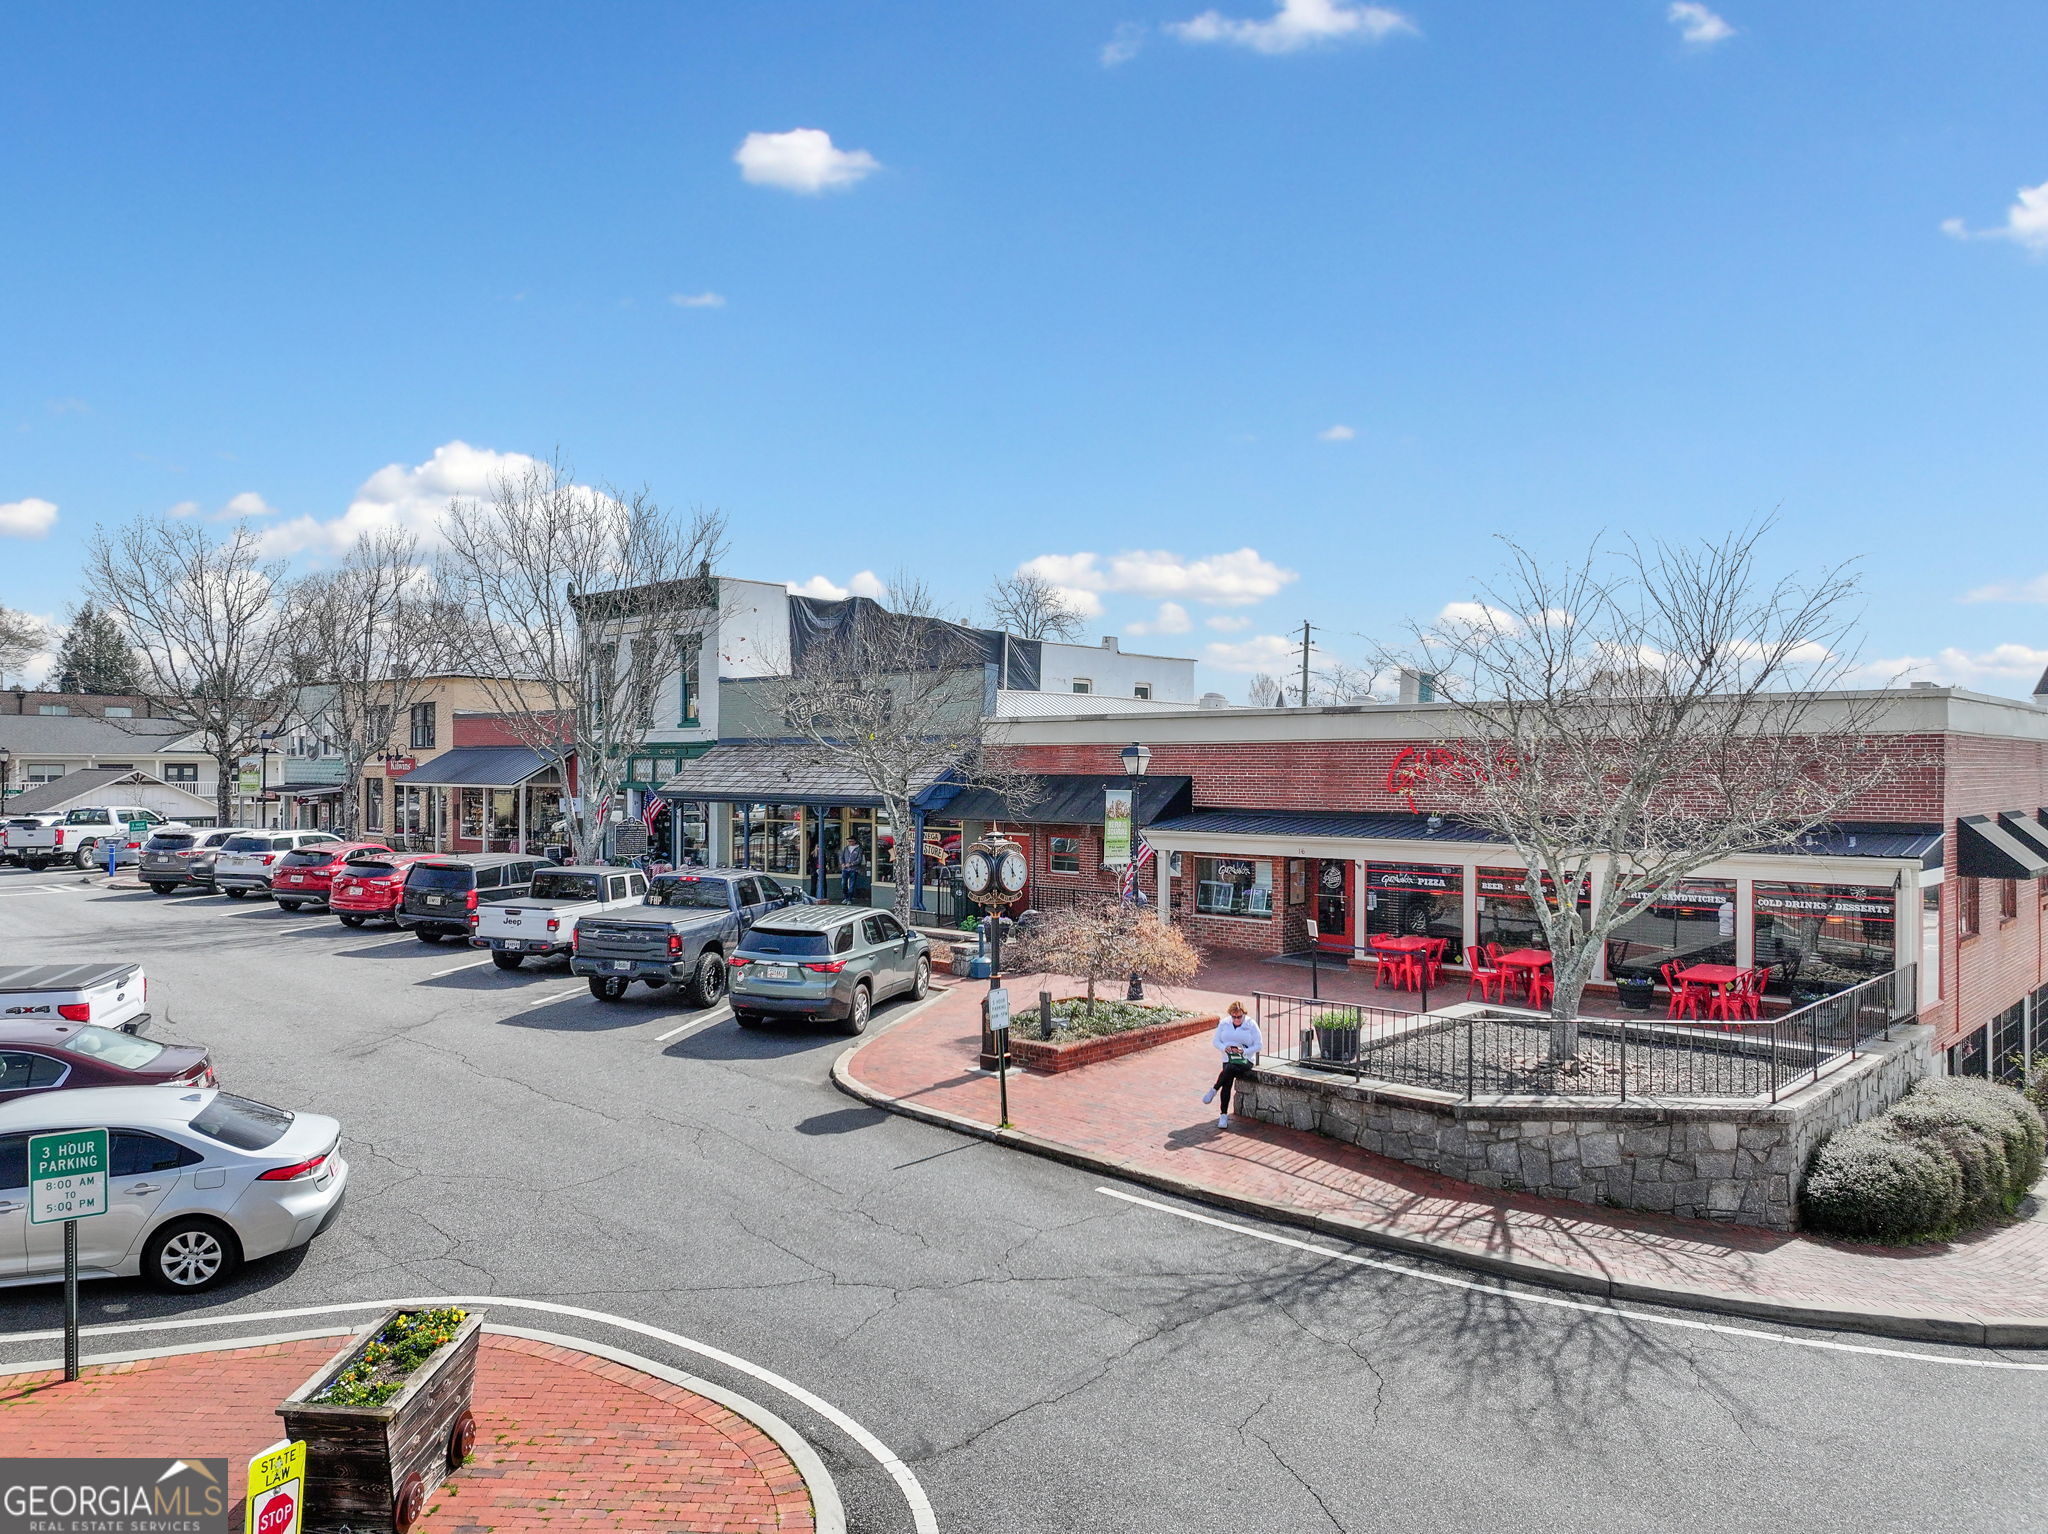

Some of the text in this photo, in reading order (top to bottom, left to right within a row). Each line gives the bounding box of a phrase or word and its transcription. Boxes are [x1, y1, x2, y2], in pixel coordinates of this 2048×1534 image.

[1417, 877, 1447, 887] PIZZA
[1481, 882, 1504, 890] BEER
[1661, 893, 1727, 904] SANDWICHES
[1757, 898, 1890, 914] COLD DRINKS DESSERTS
[503, 917, 522, 926] Jeep
[42, 1141, 95, 1158] 3 HOUR
[39, 1155, 98, 1173] PARKING
[45, 1176, 95, 1191] 8:00 AM
[65, 1191, 76, 1199] TO
[46, 1198, 95, 1213] 5:00 PM
[261, 1448, 297, 1474] STATE
[265, 1466, 291, 1487] LAW
[260, 1504, 292, 1531] STOP
